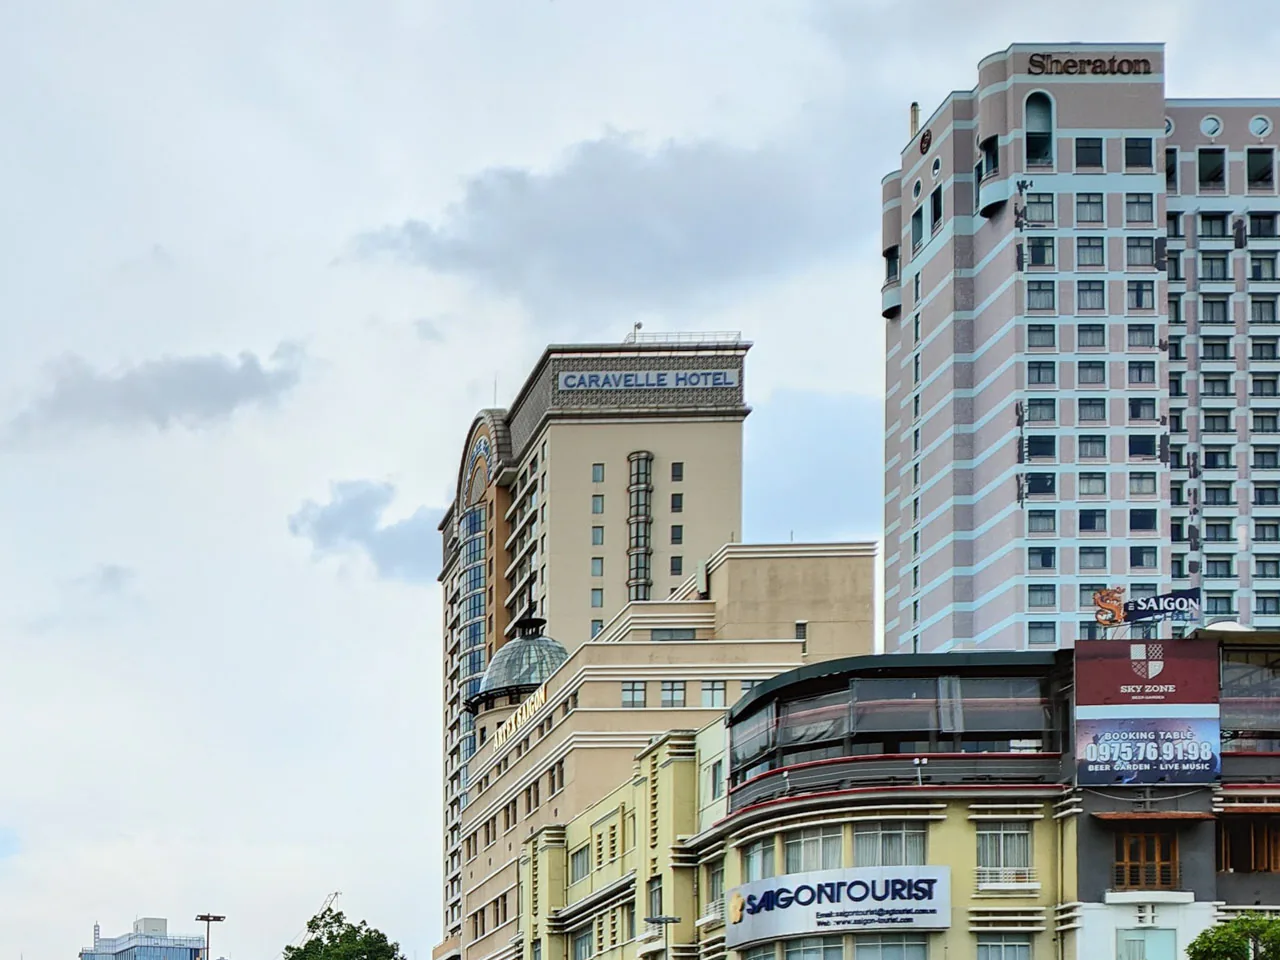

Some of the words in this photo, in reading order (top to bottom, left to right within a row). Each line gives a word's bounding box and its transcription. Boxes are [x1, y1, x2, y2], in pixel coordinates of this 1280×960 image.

[1027, 53, 1153, 75] Sheraton
[563, 372, 668, 388] CARAVELLE
[675, 371, 734, 387] HOTEL
[1137, 597, 1200, 612] SAIGON
[1120, 685, 1143, 693] SKY
[1144, 684, 1176, 693] ZONE
[1104, 732, 1156, 741] BOOKING
[1158, 731, 1194, 740] TABLE
[1086, 742, 1213, 762] 0975.76.91.98
[1088, 764, 1111, 772] BEER
[1113, 763, 1151, 771] GARDEN
[1159, 763, 1181, 771] LIVE
[1182, 763, 1210, 771] MUSIC
[746, 878, 938, 915] SAIGONTOURIST
